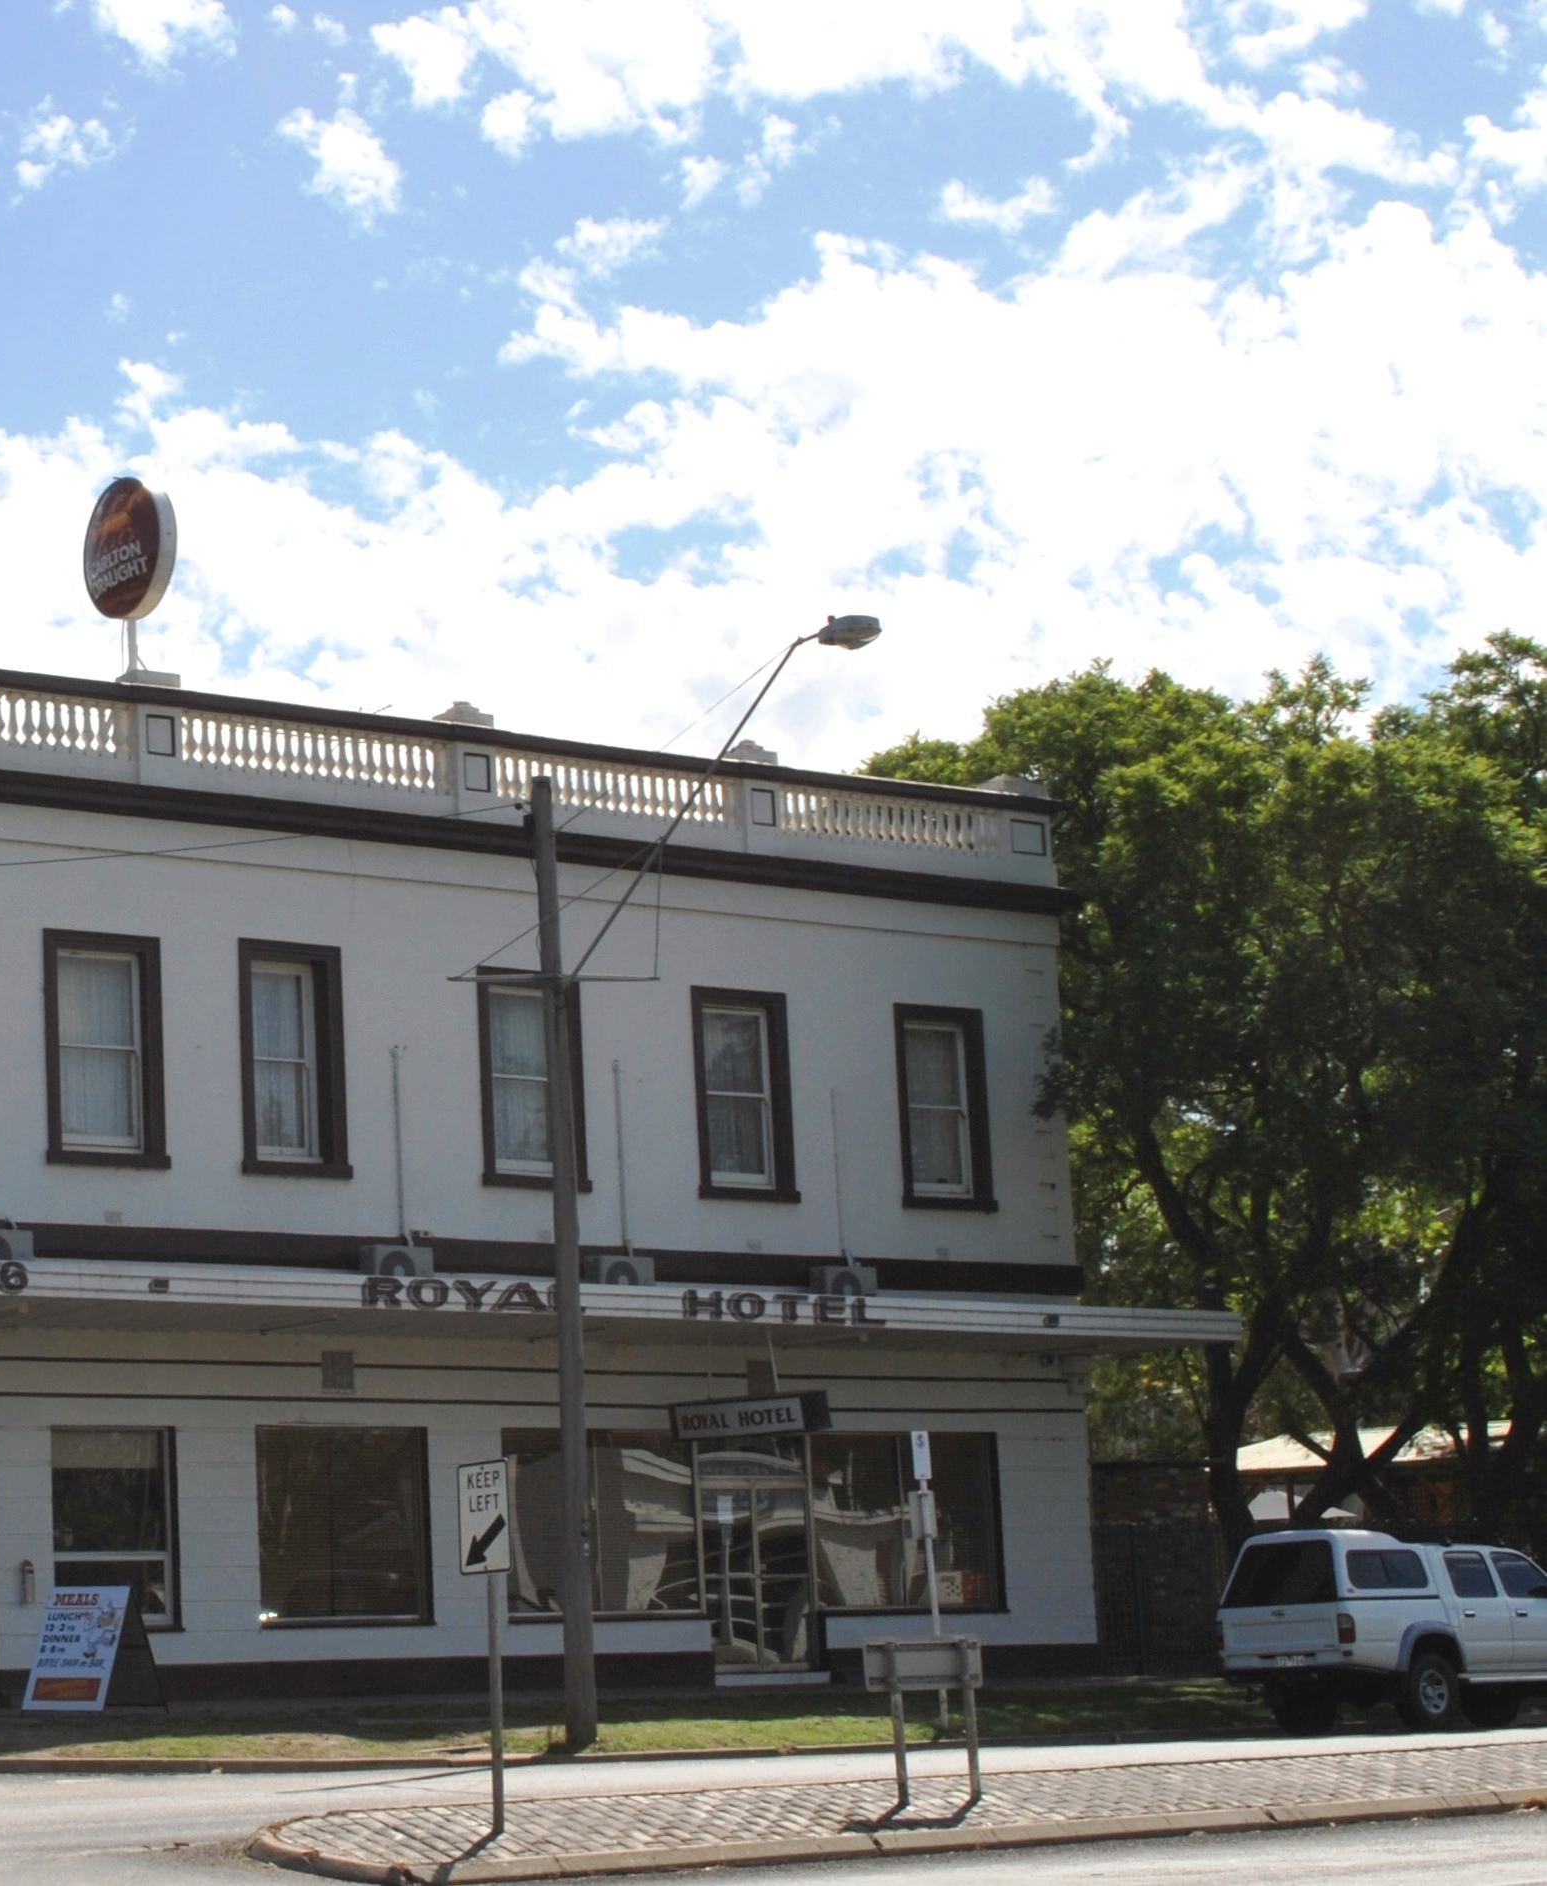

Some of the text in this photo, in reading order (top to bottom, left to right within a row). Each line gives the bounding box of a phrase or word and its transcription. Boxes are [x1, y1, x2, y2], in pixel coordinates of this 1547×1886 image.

[91, 540, 142, 579] CARLTON
[90, 556, 149, 600] DRAUGHT
[361, 1275, 887, 1327] ROYA HOTEL
[681, 1407, 796, 1431] ROYAL HOTEL
[467, 1470, 500, 1490] KEEP
[469, 1493, 499, 1513] LEFT
[53, 1593, 100, 1606] MEALS
[47, 1611, 82, 1621] LUNCH
[42, 1634, 81, 1643] DINNER
